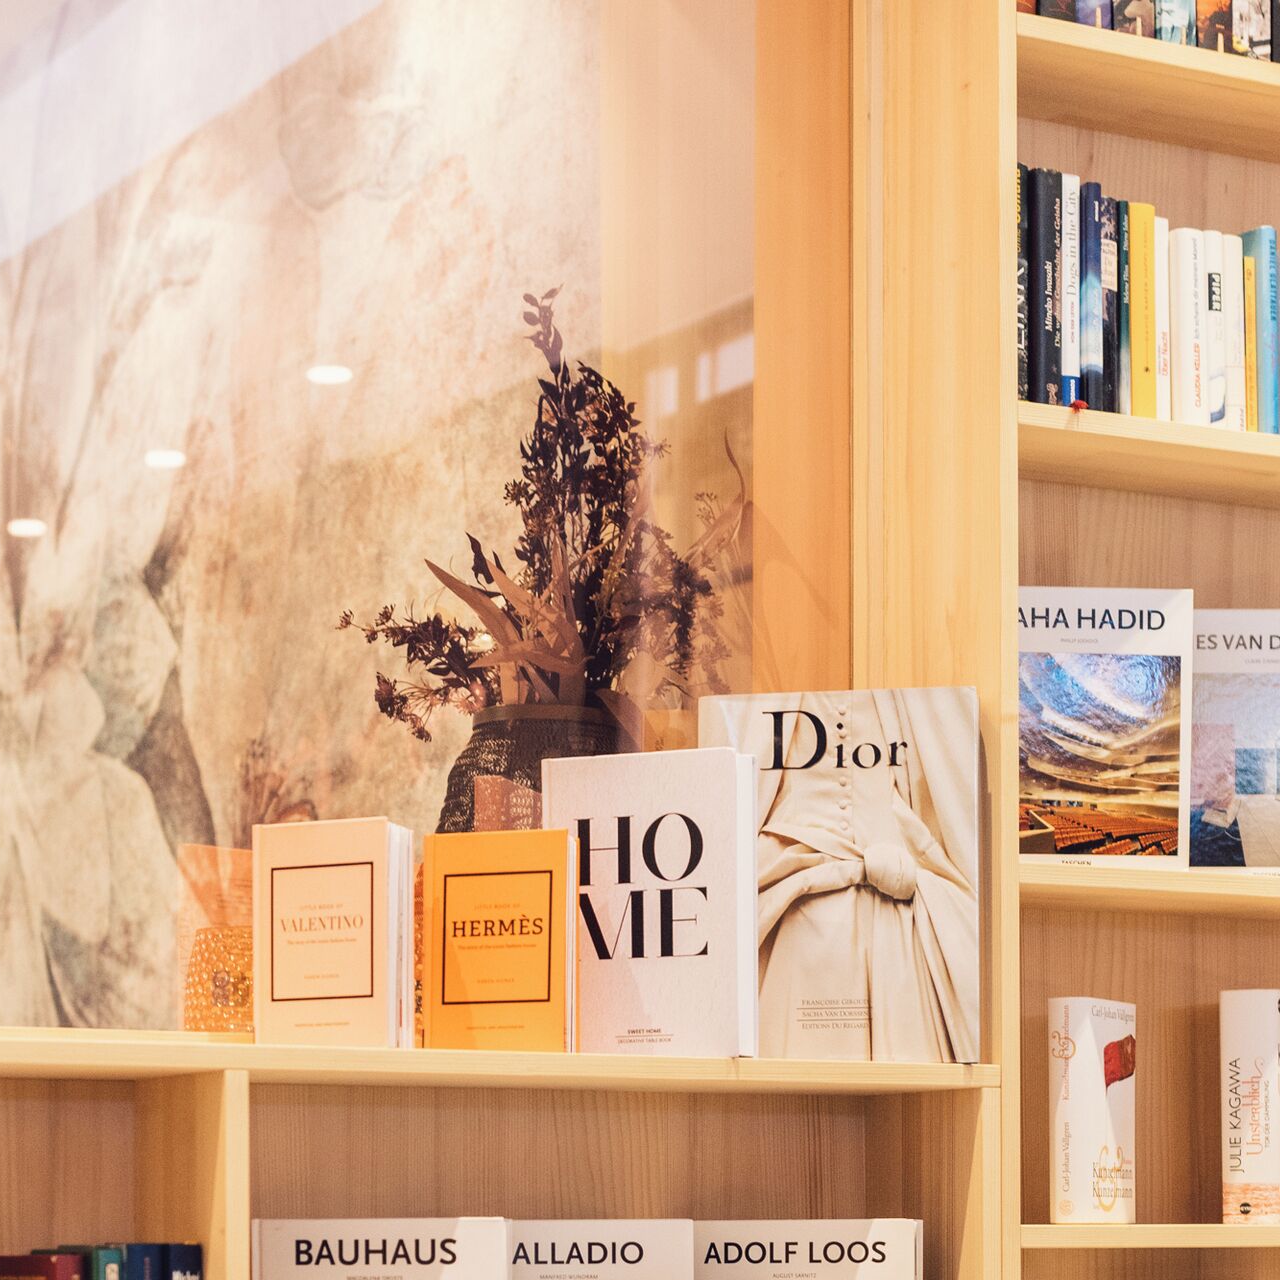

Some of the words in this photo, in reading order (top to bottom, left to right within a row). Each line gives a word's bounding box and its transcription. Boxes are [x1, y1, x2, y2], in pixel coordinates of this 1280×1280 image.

[1064, 190, 1080, 216] City
[1065, 218, 1076, 242] the
[1066, 245, 1076, 258] in
[1044, 261, 1053, 296] Iwasaki
[1065, 262, 1079, 296] Dogs
[1209, 273, 1221, 310] PIPER
[1044, 297, 1053, 331] Mineko
[1161, 331, 1169, 355] Nacht
[1161, 357, 1169, 377] Über
[1194, 373, 1202, 408] CLAUDIA
[1077, 609, 1165, 630] HADID
[1196, 634, 1218, 650] ES
[1222, 634, 1263, 650] VAN
[760, 708, 909, 774] Dior
[572, 811, 706, 888] HO
[280, 915, 364, 932] VALENTINO
[452, 914, 544, 938] HERMÈS
[1091, 1005, 1117, 1019] Carl-Johan
[1229, 1057, 1241, 1130] KAGAWA
[1242, 1056, 1265, 1156] Unsterblich
[1063, 1122, 1072, 1151] Vallgren
[1229, 1137, 1244, 1173] JULIE
[294, 1238, 457, 1266] BAUHAUS
[512, 1240, 645, 1265] ALLADIO
[703, 1241, 799, 1265] ADOLF
[807, 1240, 887, 1264] LOOS
[568, 1273, 599, 1280] WUNDRAM
